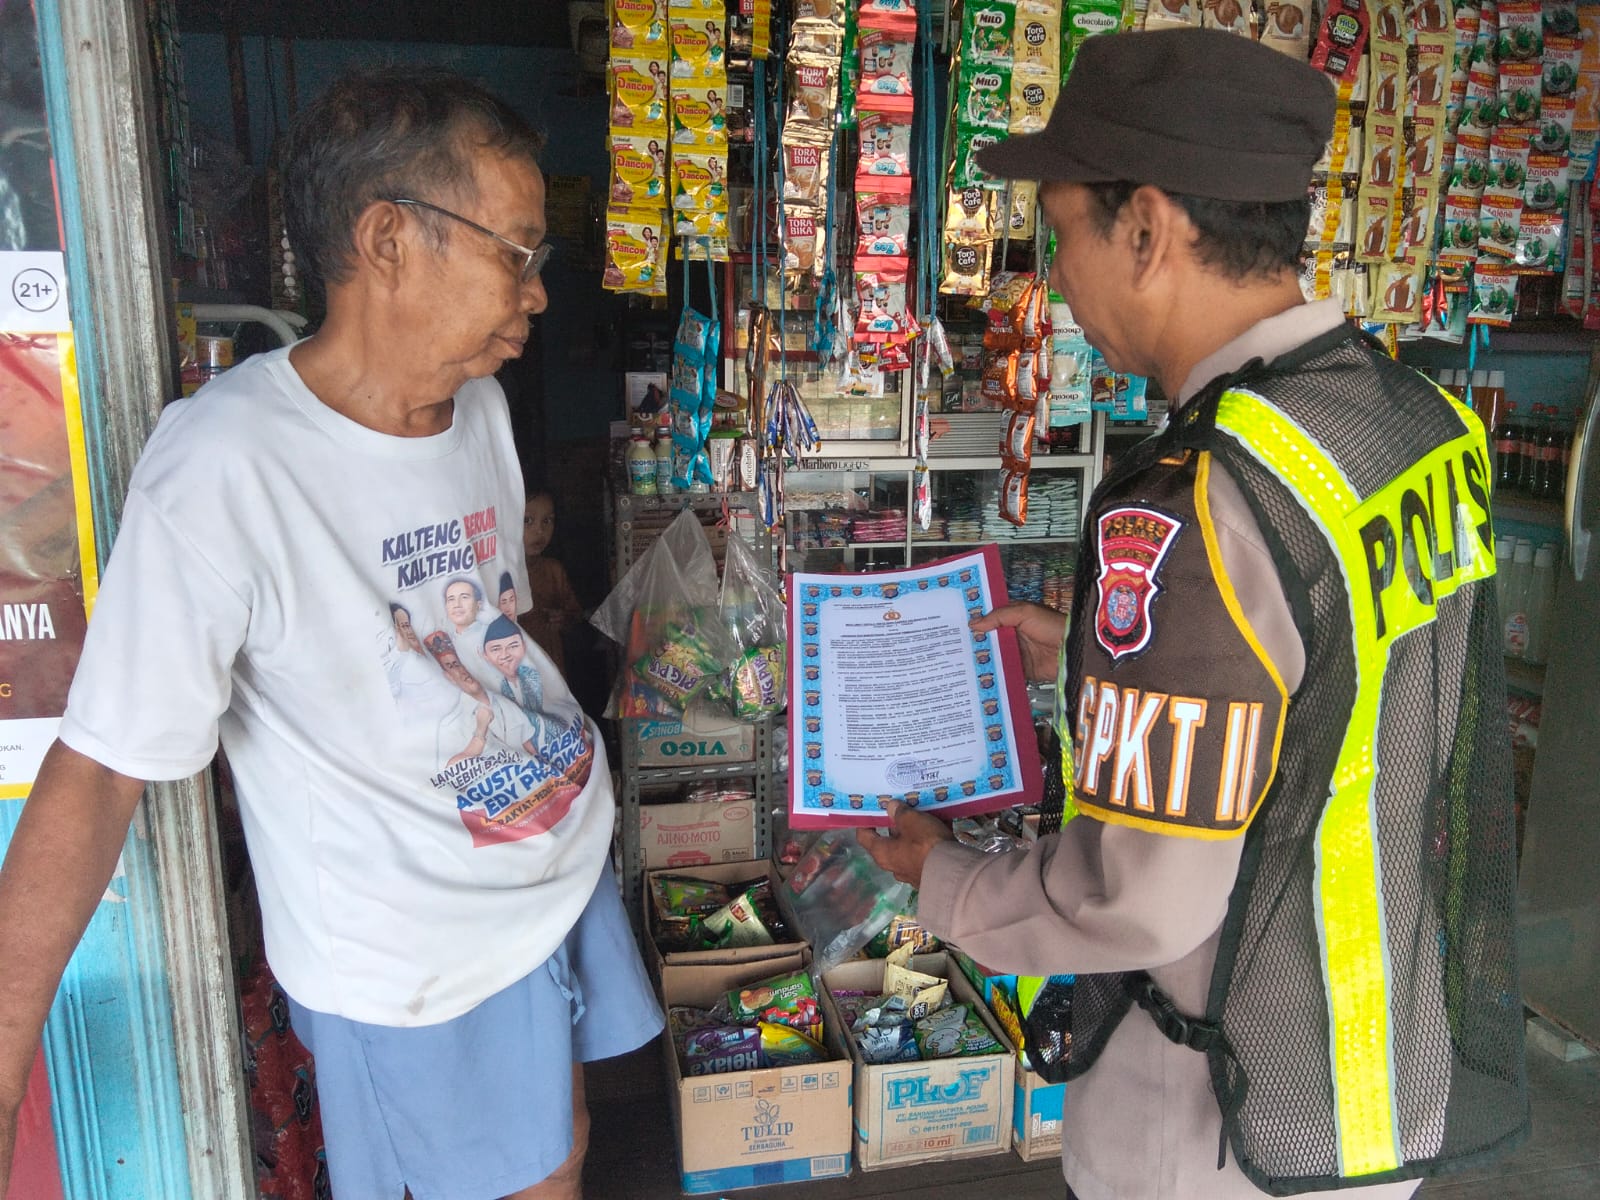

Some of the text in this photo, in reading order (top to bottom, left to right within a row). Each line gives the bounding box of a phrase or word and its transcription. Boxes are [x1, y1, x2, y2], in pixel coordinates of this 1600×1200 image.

[980, 14, 1002, 25] MILO
[1508, 14, 1534, 23] Anlene
[1026, 26, 1044, 35] Tora
[674, 34, 708, 46] Dancow
[1027, 33, 1045, 43] Cafe
[801, 67, 825, 77] TORA
[617, 77, 654, 92] Dancow
[802, 76, 824, 86] BIKA
[975, 77, 998, 87] MILO
[1024, 88, 1042, 97] Tora
[1026, 95, 1044, 103] Cafe
[676, 103, 709, 115] Dancow
[1541, 111, 1566, 119] nlene
[792, 147, 816, 157] TORA
[616, 155, 653, 169] Dancow
[794, 155, 818, 165] BIKA
[678, 170, 711, 180] Dancow
[1527, 168, 1559, 177] Anlene
[963, 191, 981, 199] Tora
[963, 198, 982, 207] Cafe
[788, 219, 812, 227] TORA
[790, 225, 814, 235] BIKA
[1520, 226, 1551, 236] Anlene
[611, 240, 646, 255] Dancow
[957, 250, 975, 259] Tora
[958, 257, 976, 266] Cafe
[1481, 275, 1510, 284] Anlene
[19, 281, 52, 299] 21+
[802, 458, 838, 470] Marlboro
[382, 519, 462, 563] KALTENG
[397, 544, 475, 589] KALTENG
[649, 724, 681, 737] BONUS
[659, 741, 727, 756] VIGO
[1073, 676, 1206, 818] SPKT
[449, 764, 483, 790] LEBIH
[484, 783, 520, 818] EDY
[768, 983, 804, 997] Gandum
[780, 989, 798, 1000] Sari
[740, 1122, 794, 1141] TULIP
